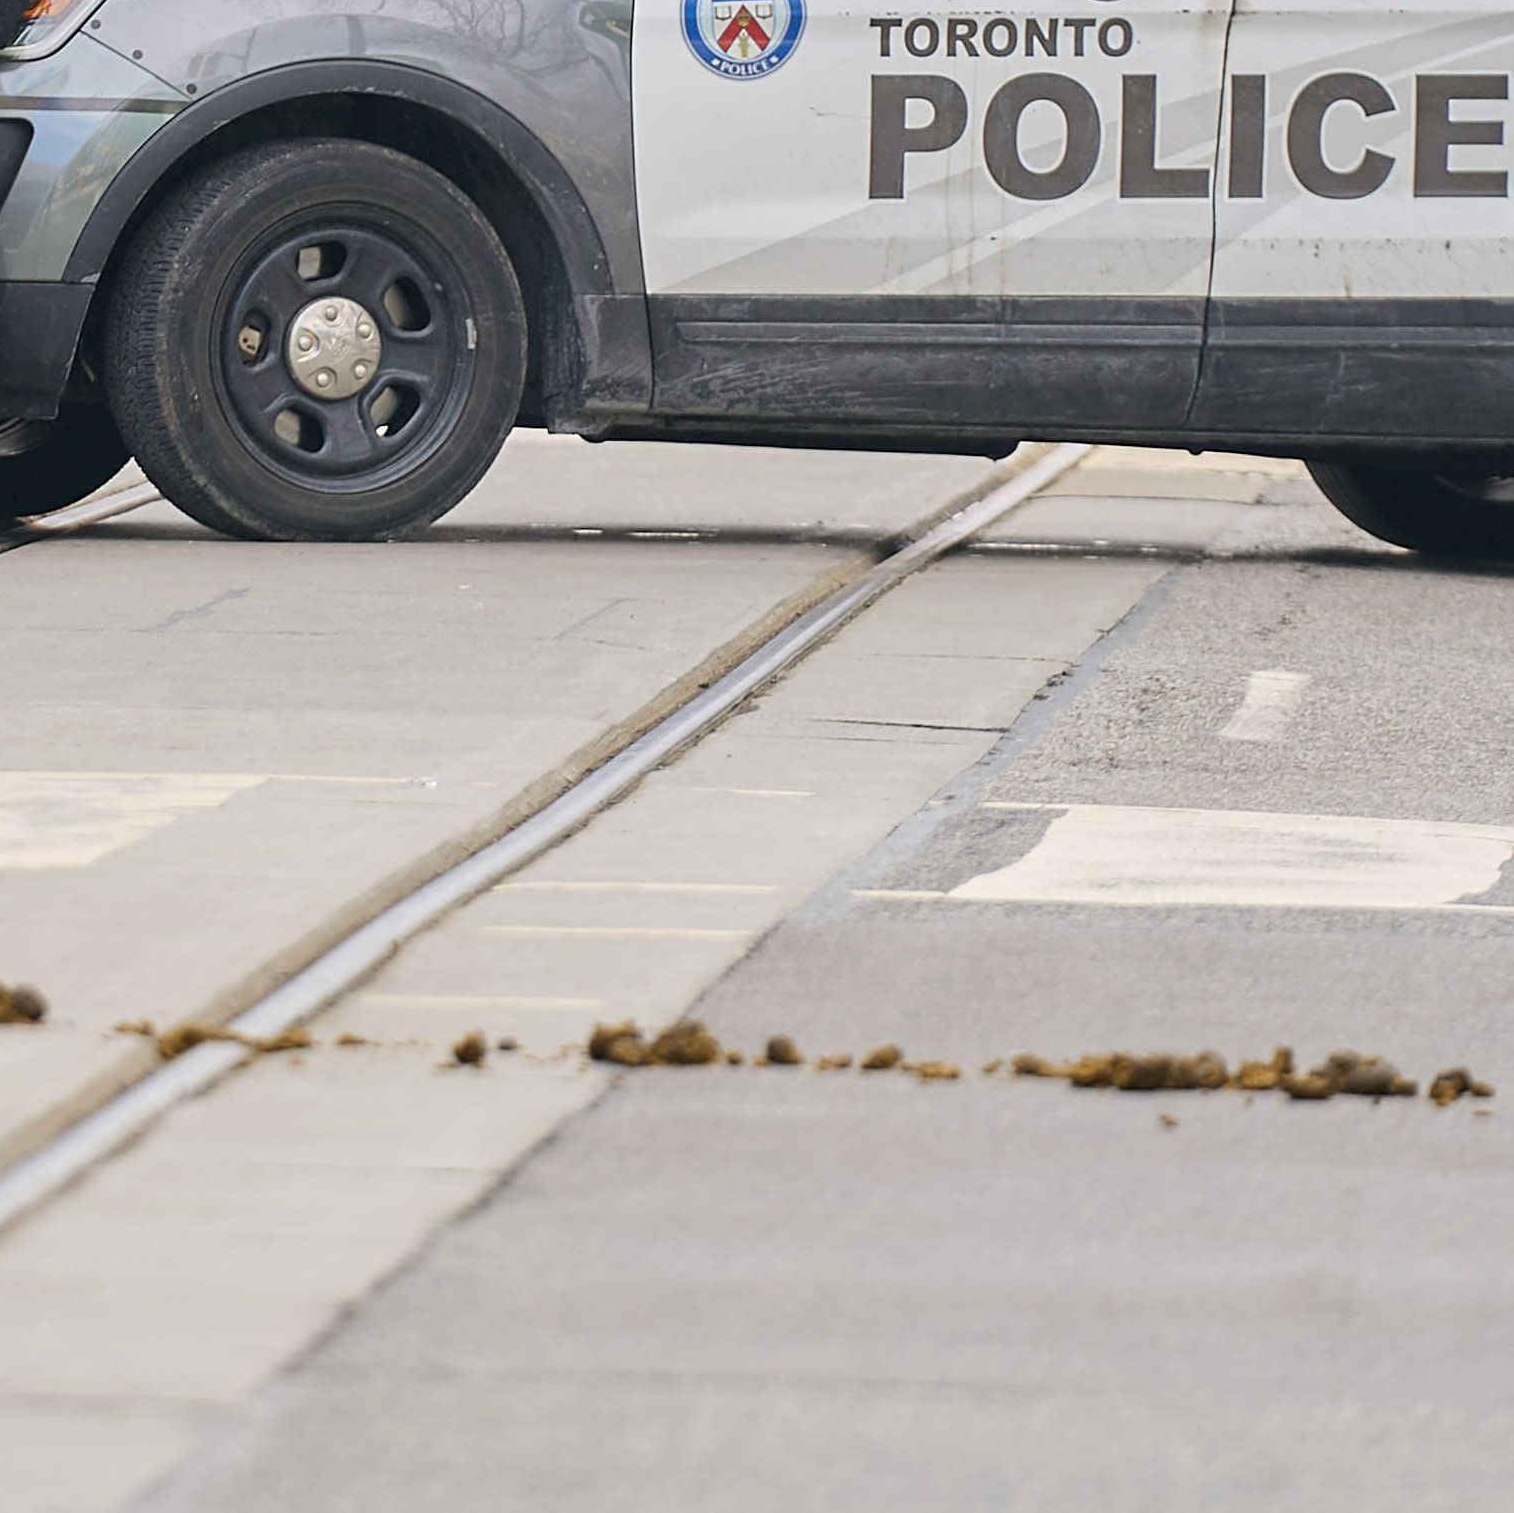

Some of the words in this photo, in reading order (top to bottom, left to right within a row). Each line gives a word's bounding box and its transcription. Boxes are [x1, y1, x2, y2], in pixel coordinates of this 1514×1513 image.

[870, 18, 1134, 57] TORONTO
[719, 59, 770, 76] POLICE
[868, 72, 1509, 200] POLICE
